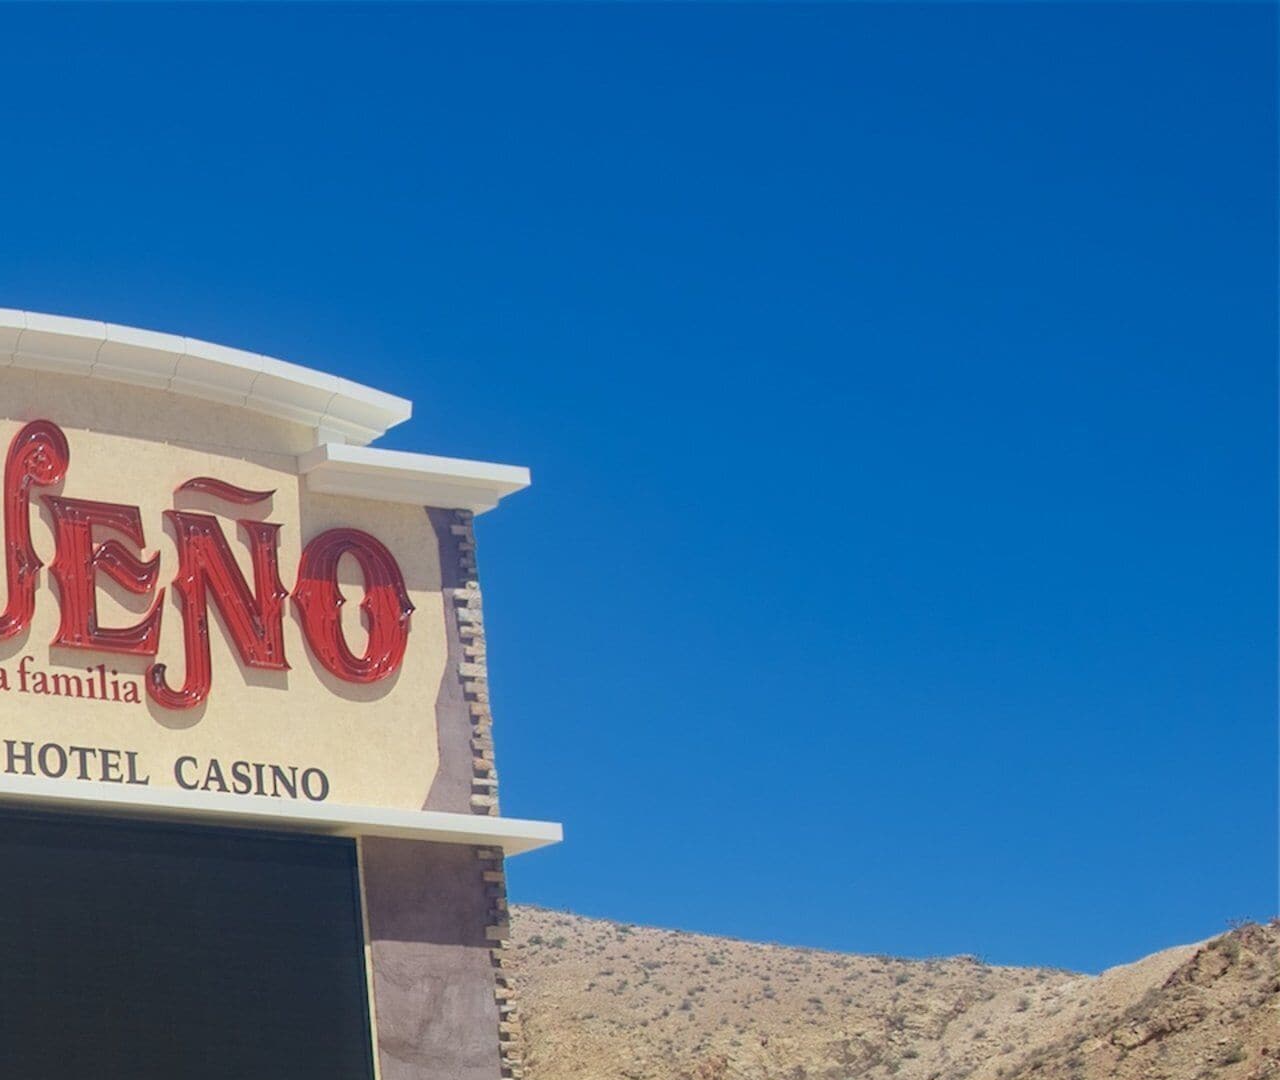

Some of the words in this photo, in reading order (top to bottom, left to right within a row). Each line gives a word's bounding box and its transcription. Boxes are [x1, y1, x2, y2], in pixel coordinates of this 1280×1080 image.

[17, 655, 142, 704] familia
[3, 739, 150, 786] HOTEL
[173, 755, 330, 802] CASINO
